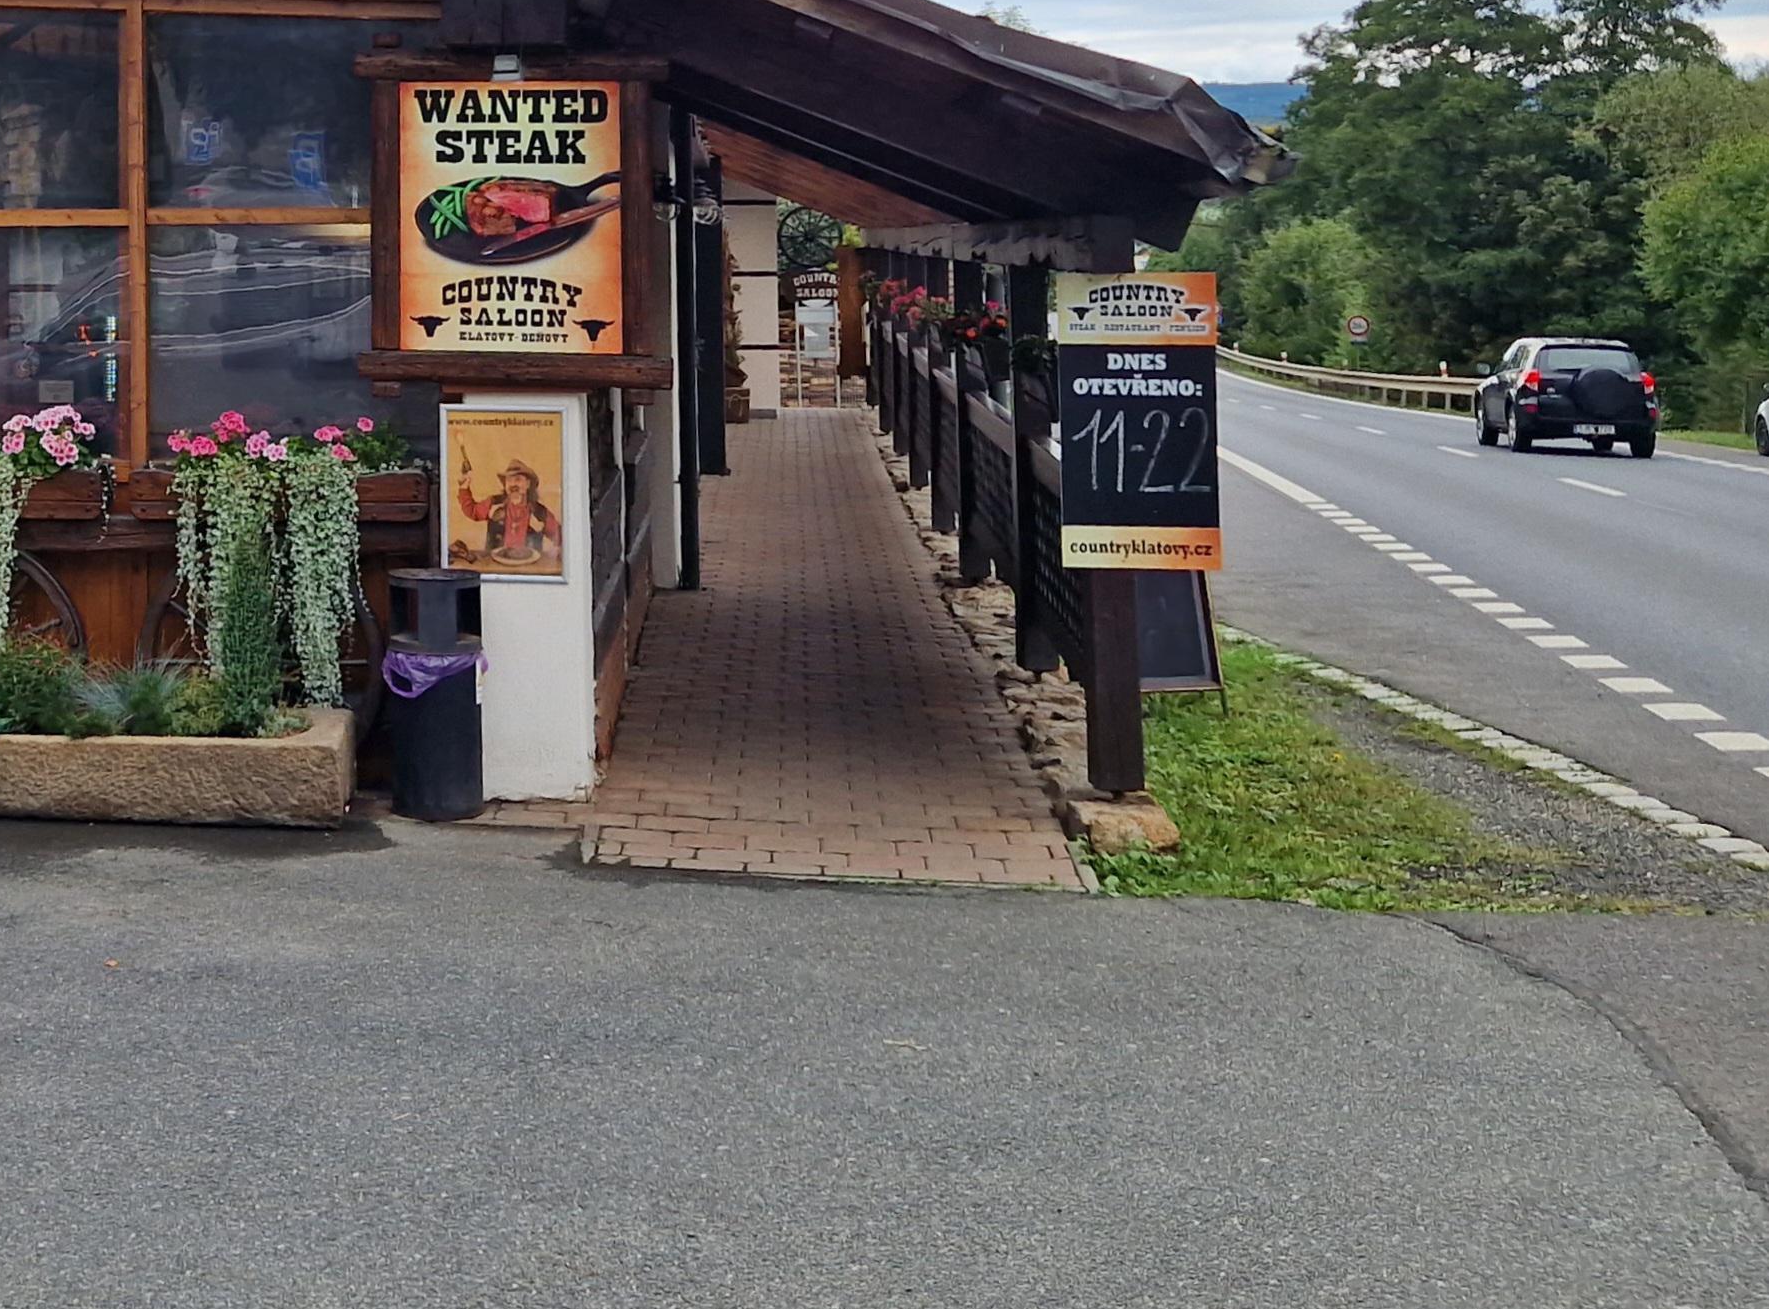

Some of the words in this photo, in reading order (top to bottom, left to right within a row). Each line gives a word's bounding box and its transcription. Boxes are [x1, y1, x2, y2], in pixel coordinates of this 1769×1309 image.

[414, 89, 609, 124] WANTED
[435, 130, 586, 164] STEAK
[793, 272, 840, 287] COUNTR
[442, 276, 583, 308] COUNTRY
[1089, 284, 1185, 304] COUNTRY
[460, 307, 567, 327] SALOON
[1100, 305, 1173, 317] SALOON
[1106, 353, 1167, 371] DNES
[1072, 373, 1204, 397] OTEVŘENO:
[1069, 539, 1213, 561] countryklatovy.cz
